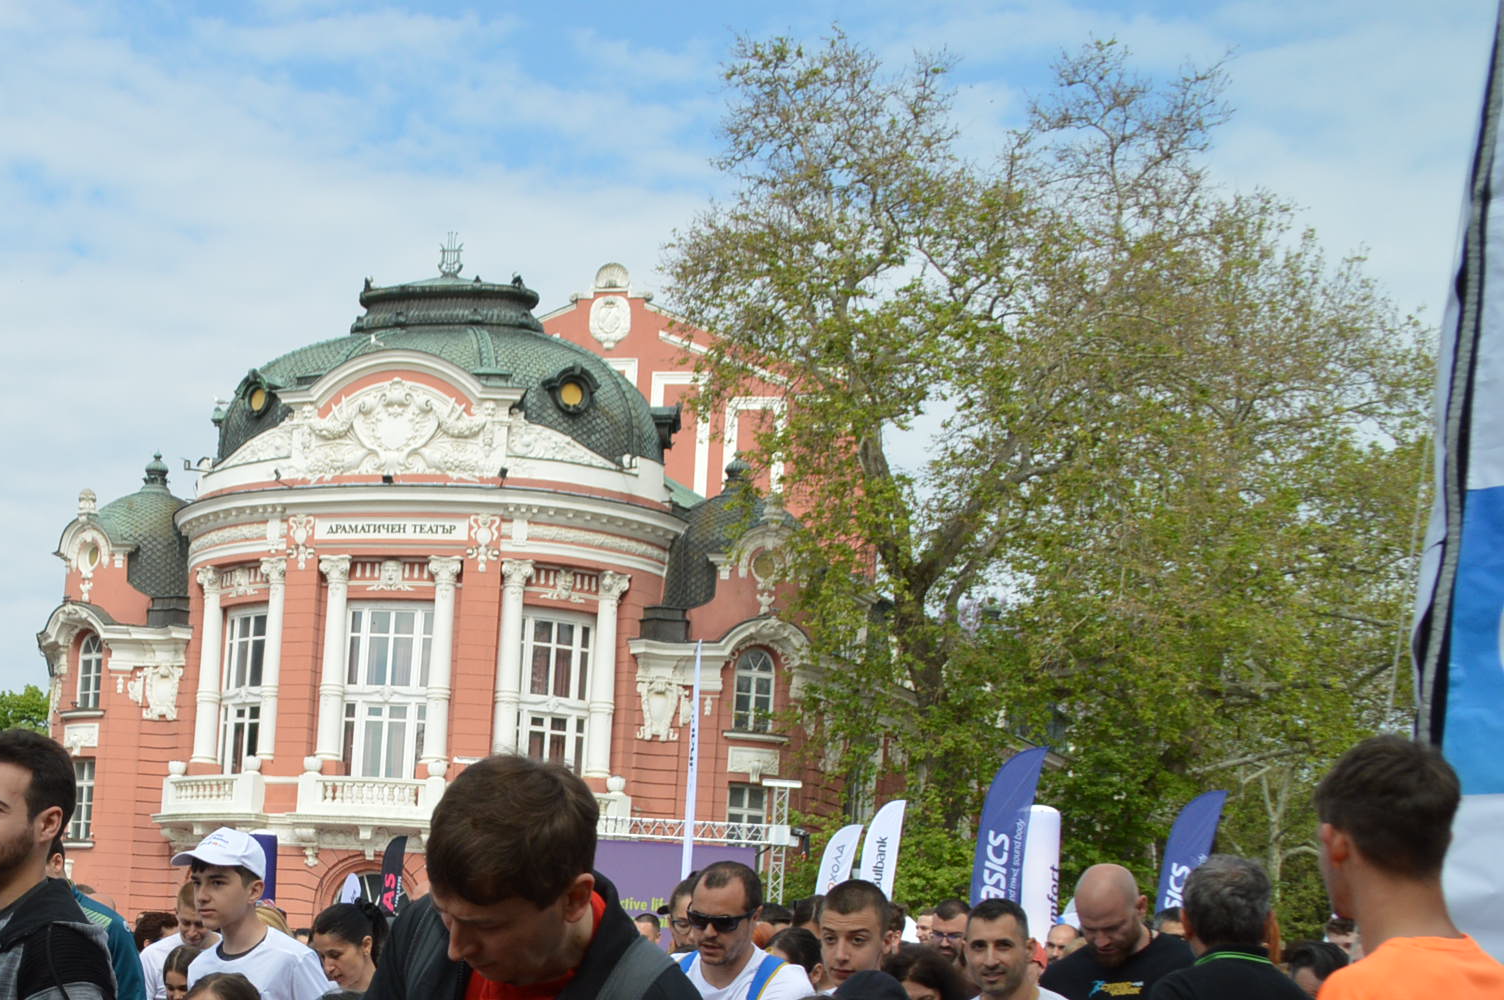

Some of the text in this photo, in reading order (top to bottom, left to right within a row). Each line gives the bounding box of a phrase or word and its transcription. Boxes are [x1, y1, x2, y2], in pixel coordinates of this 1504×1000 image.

[326, 522, 457, 535] ДРАМАТИЧЕН ТЕАТЪР
[1015, 818, 1027, 840] body
